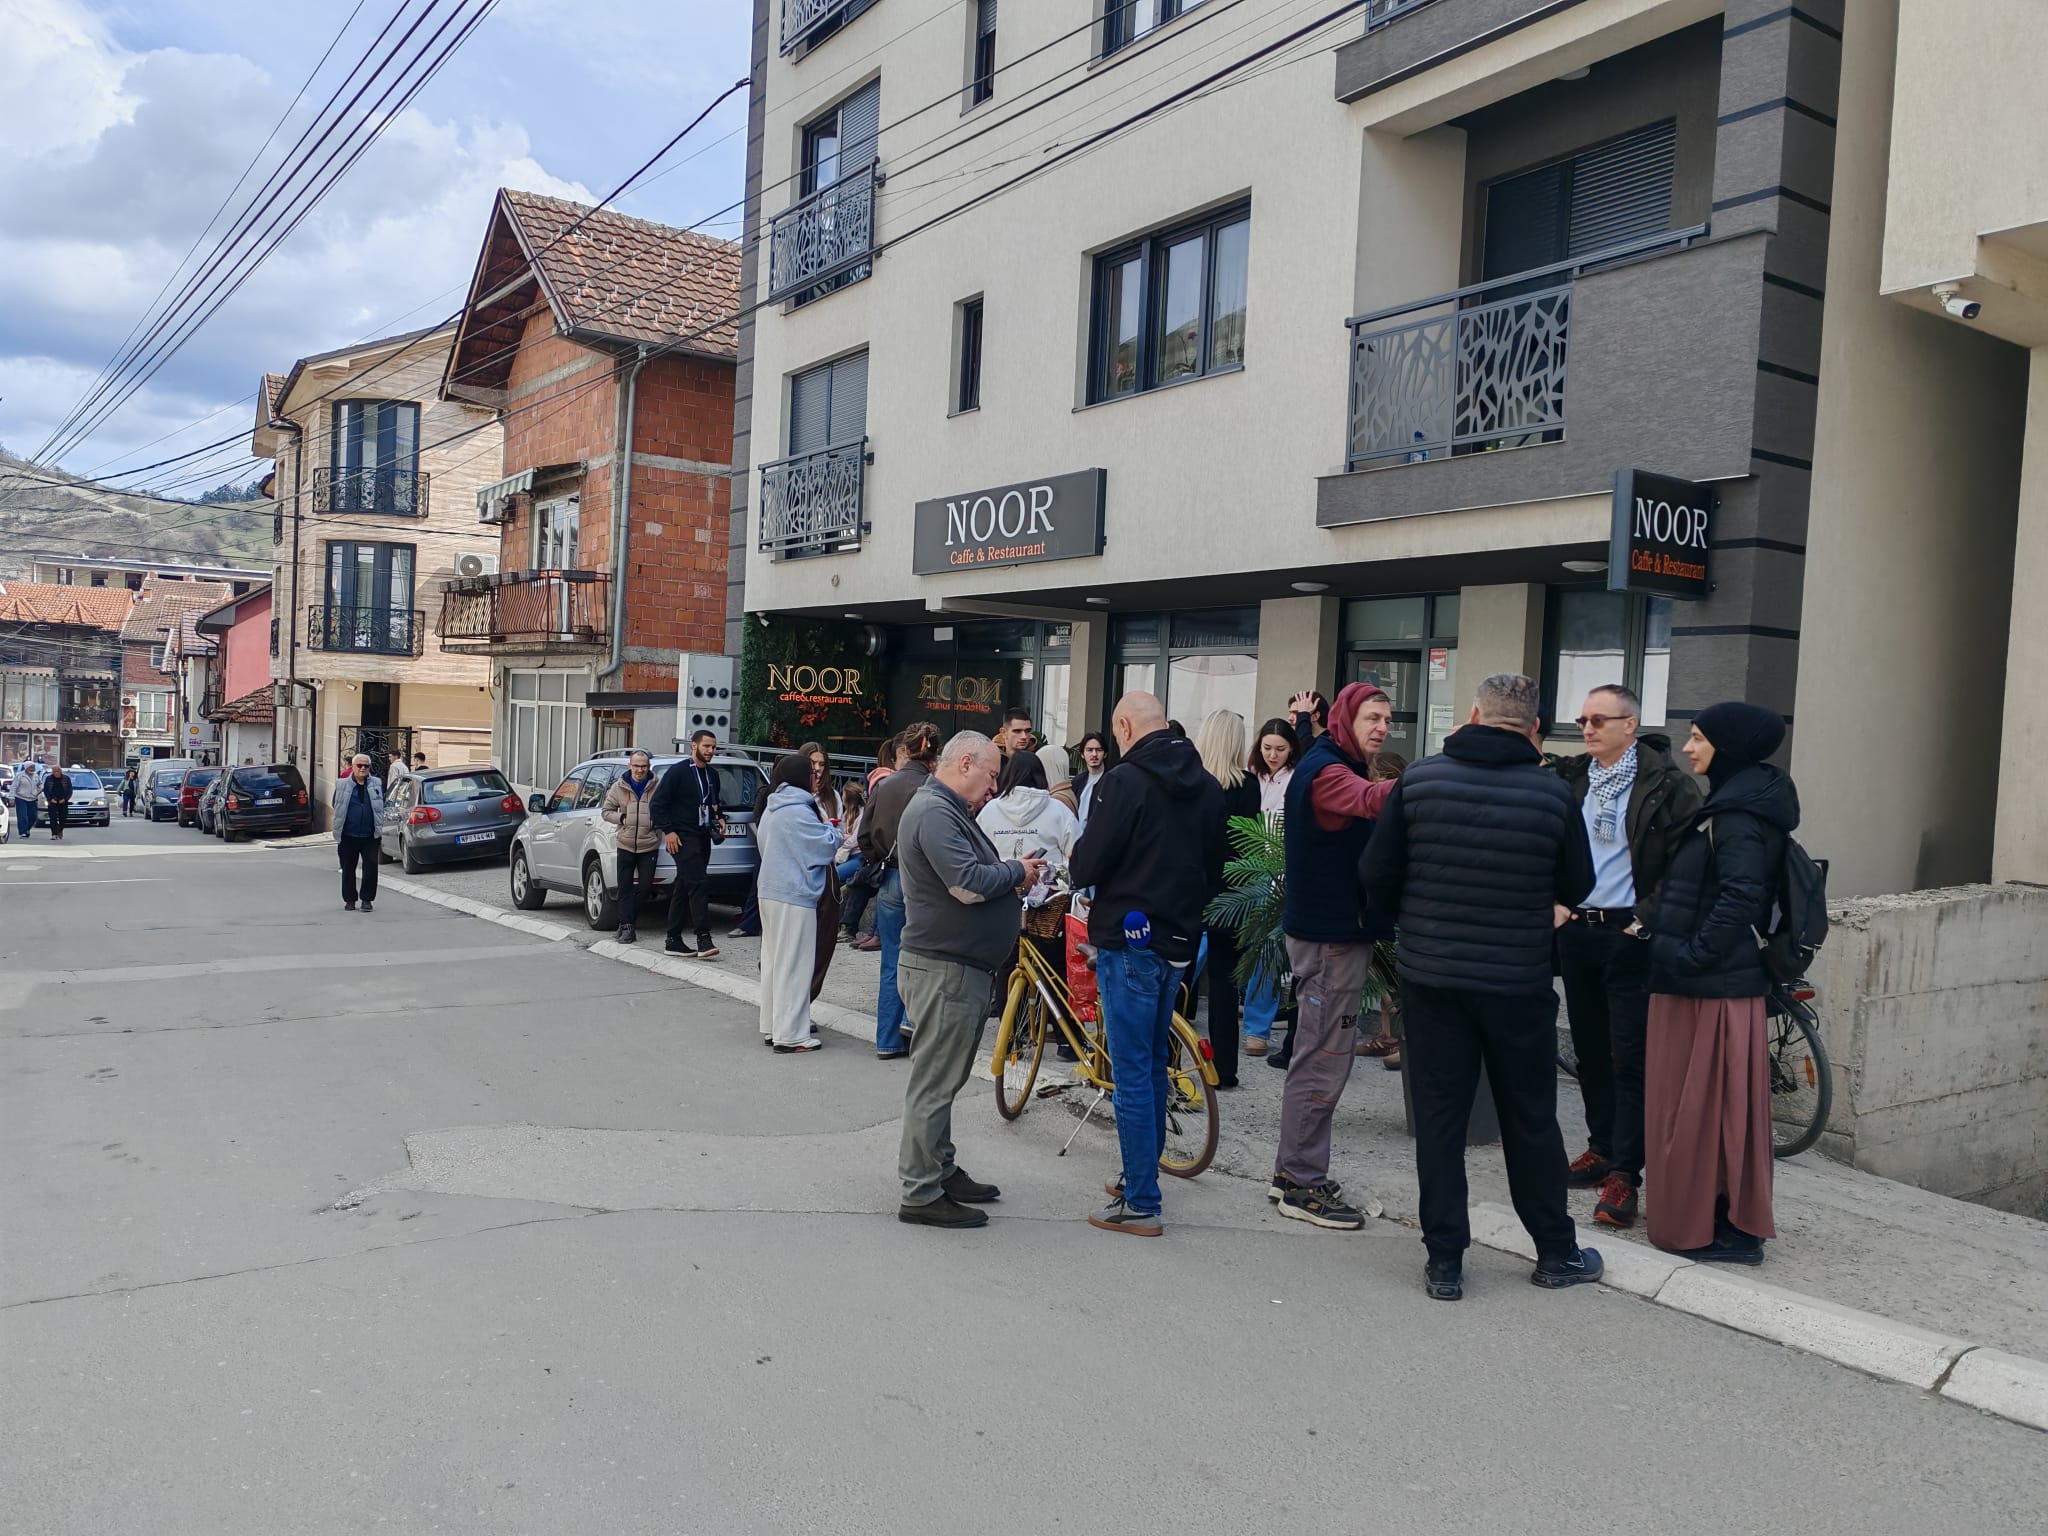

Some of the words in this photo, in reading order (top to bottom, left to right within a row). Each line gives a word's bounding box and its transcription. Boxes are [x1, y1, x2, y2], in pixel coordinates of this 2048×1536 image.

[945, 485, 1054, 546] NOOR
[1633, 497, 1708, 549] NOOR
[950, 548, 974, 565] Caffe
[977, 547, 985, 562] &
[987, 540, 1046, 561] Restaurant
[1632, 549, 1653, 572] Caffe
[1654, 553, 1661, 573] &
[1662, 554, 1705, 580] Restaurant
[767, 663, 863, 695] NOOR
